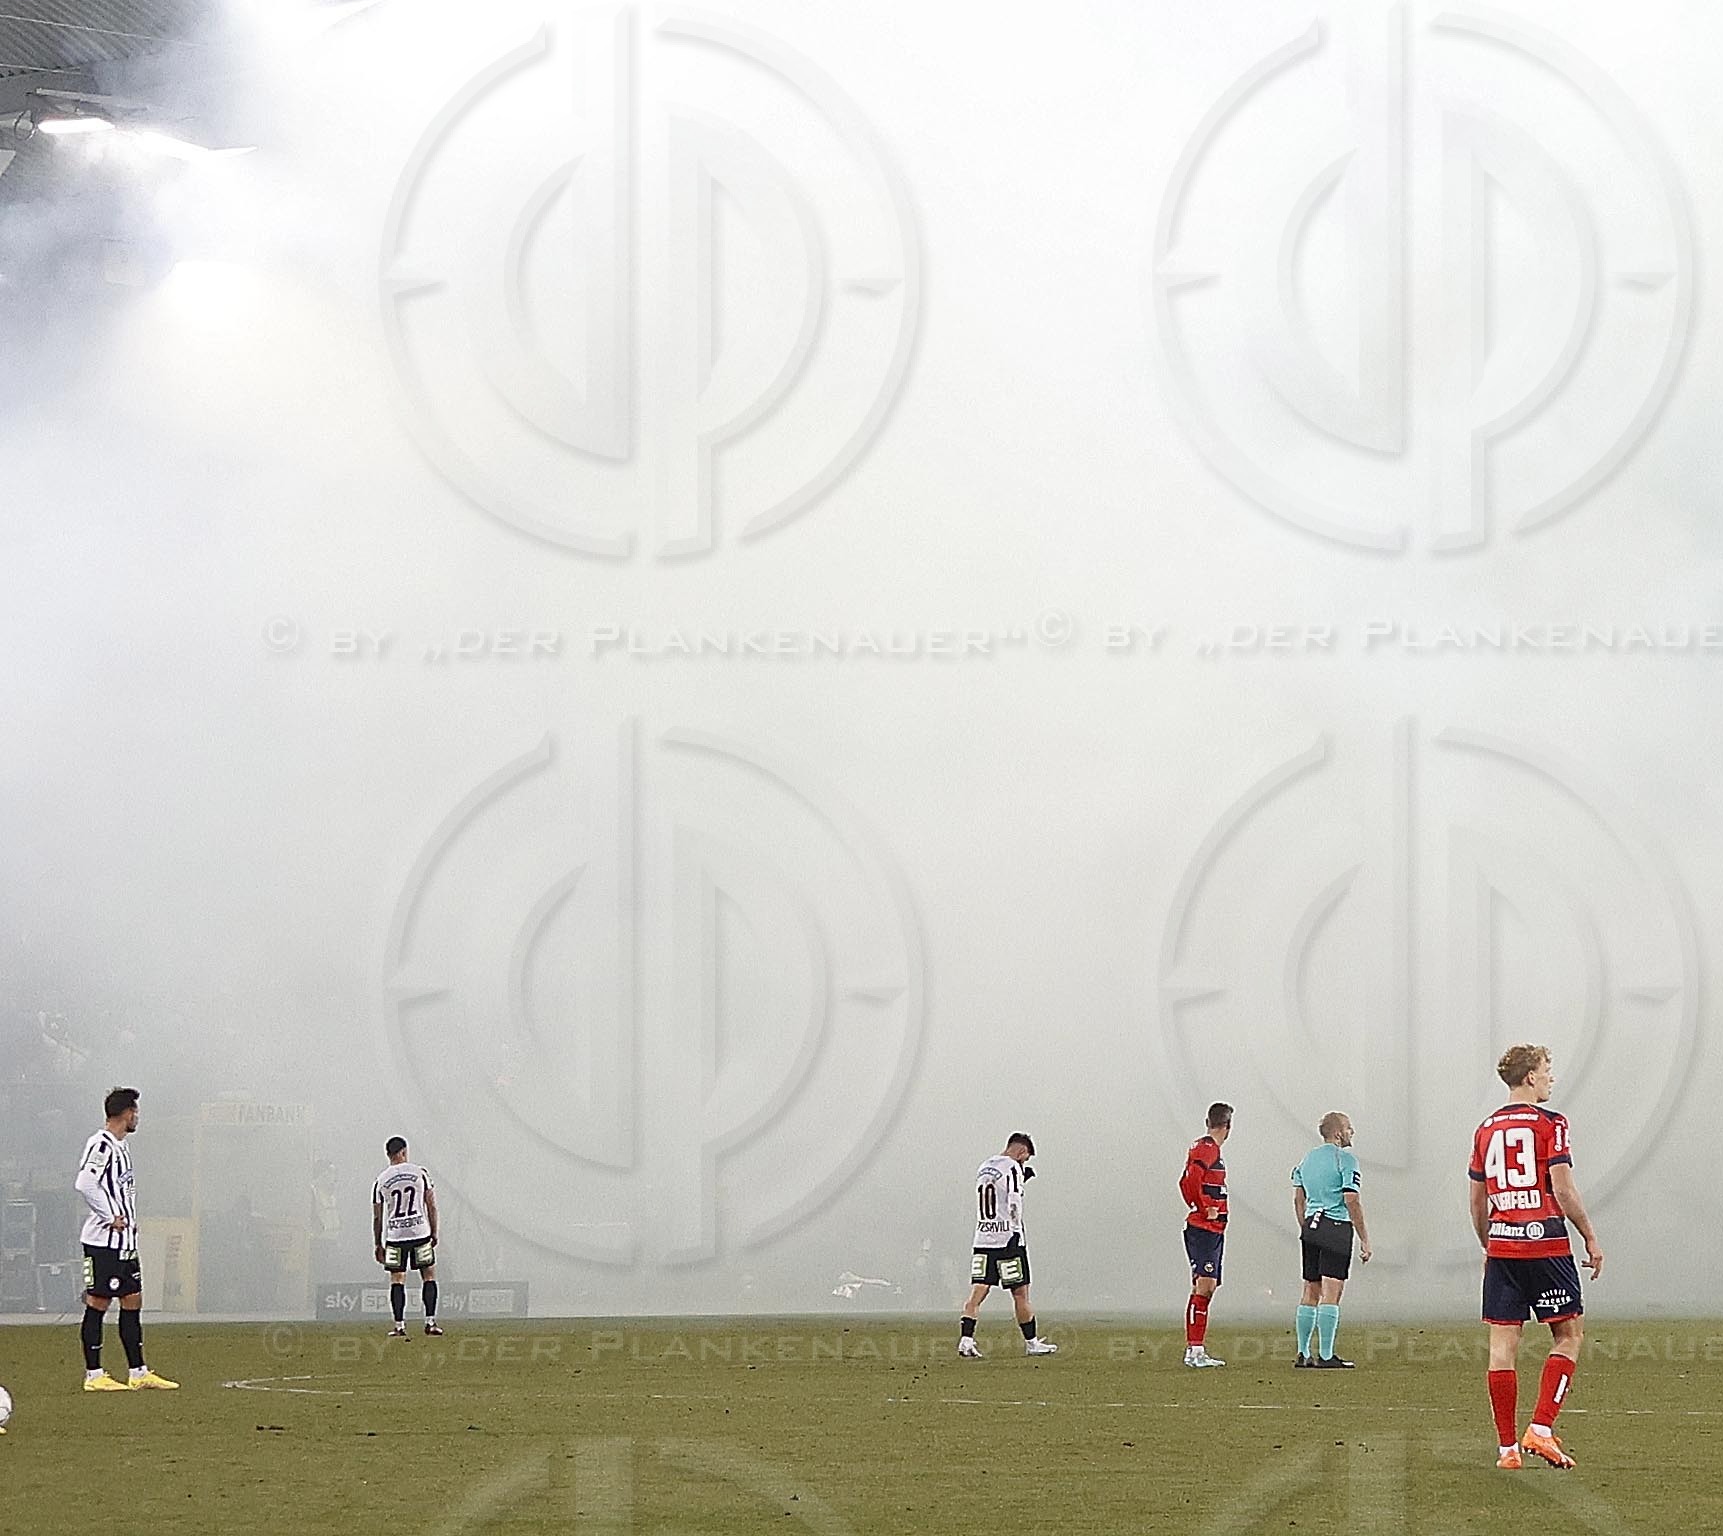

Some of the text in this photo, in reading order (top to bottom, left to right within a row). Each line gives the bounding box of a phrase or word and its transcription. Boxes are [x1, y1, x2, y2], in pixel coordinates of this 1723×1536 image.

[1485, 1127, 1538, 1190] 43
[390, 1186, 418, 1219] 22
[978, 1183, 997, 1220] 10
[325, 1291, 358, 1312] sky
